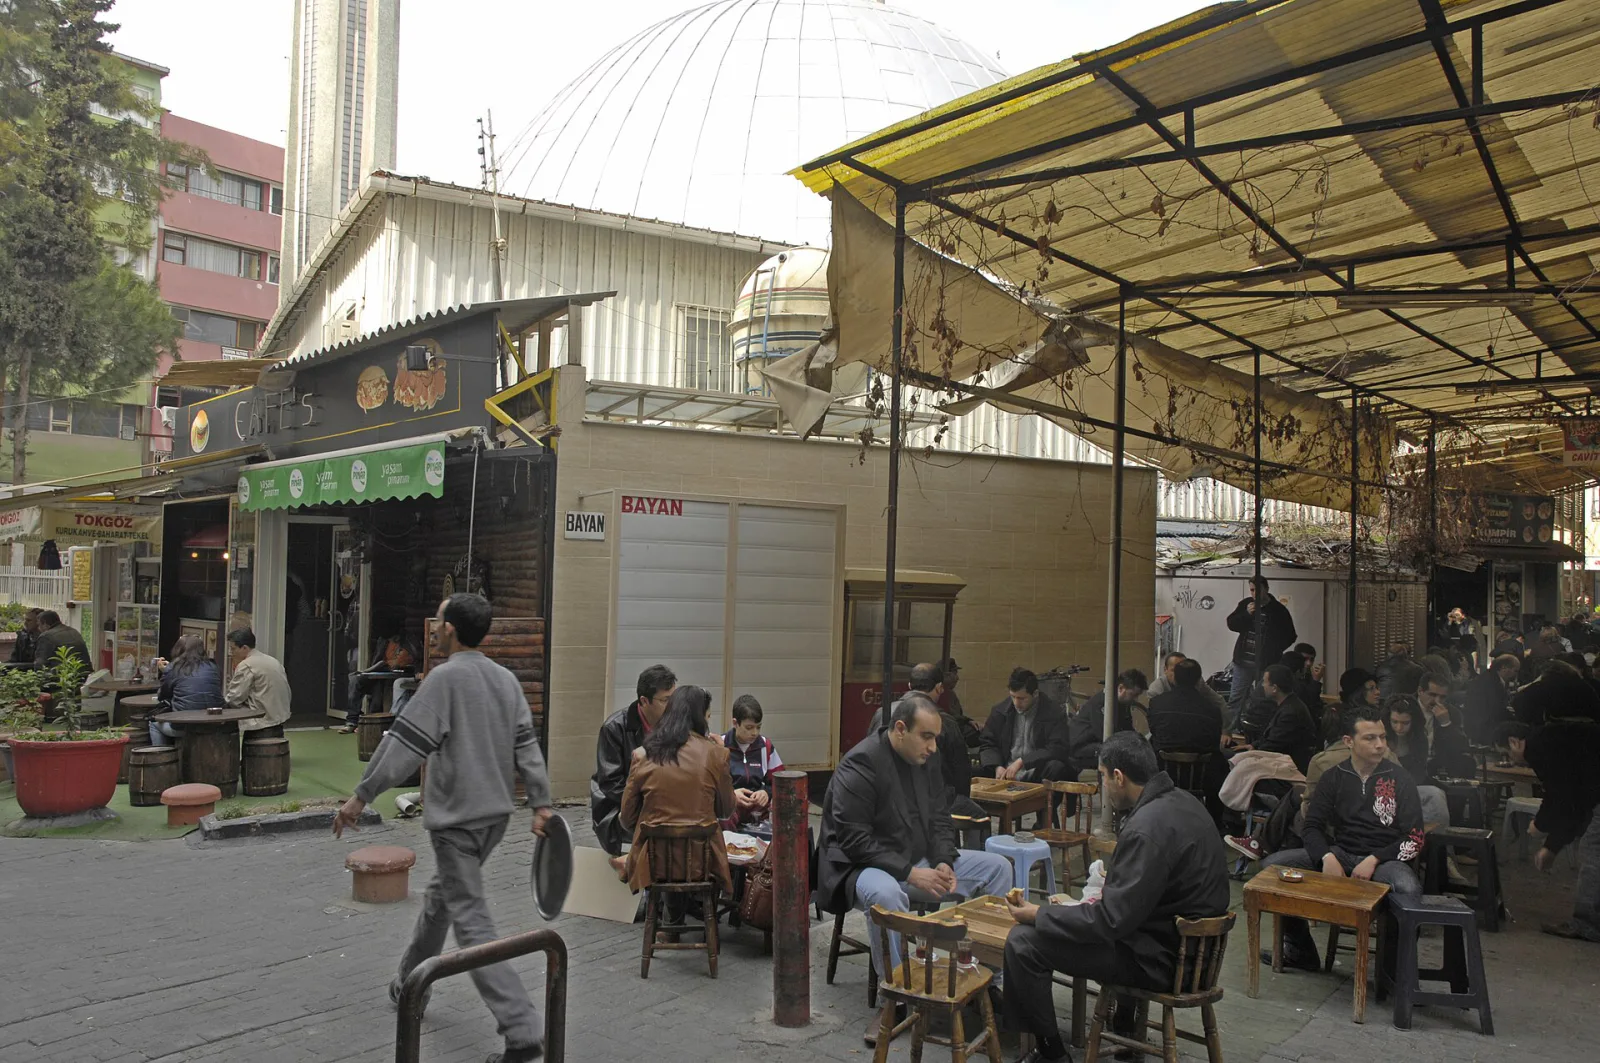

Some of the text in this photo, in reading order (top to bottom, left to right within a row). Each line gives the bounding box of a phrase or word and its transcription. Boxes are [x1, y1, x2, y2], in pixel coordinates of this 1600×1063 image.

[621, 495, 683, 516] BAYAN
[75, 514, 133, 529] TOKGÖZ
[566, 513, 605, 533] BAYAN
